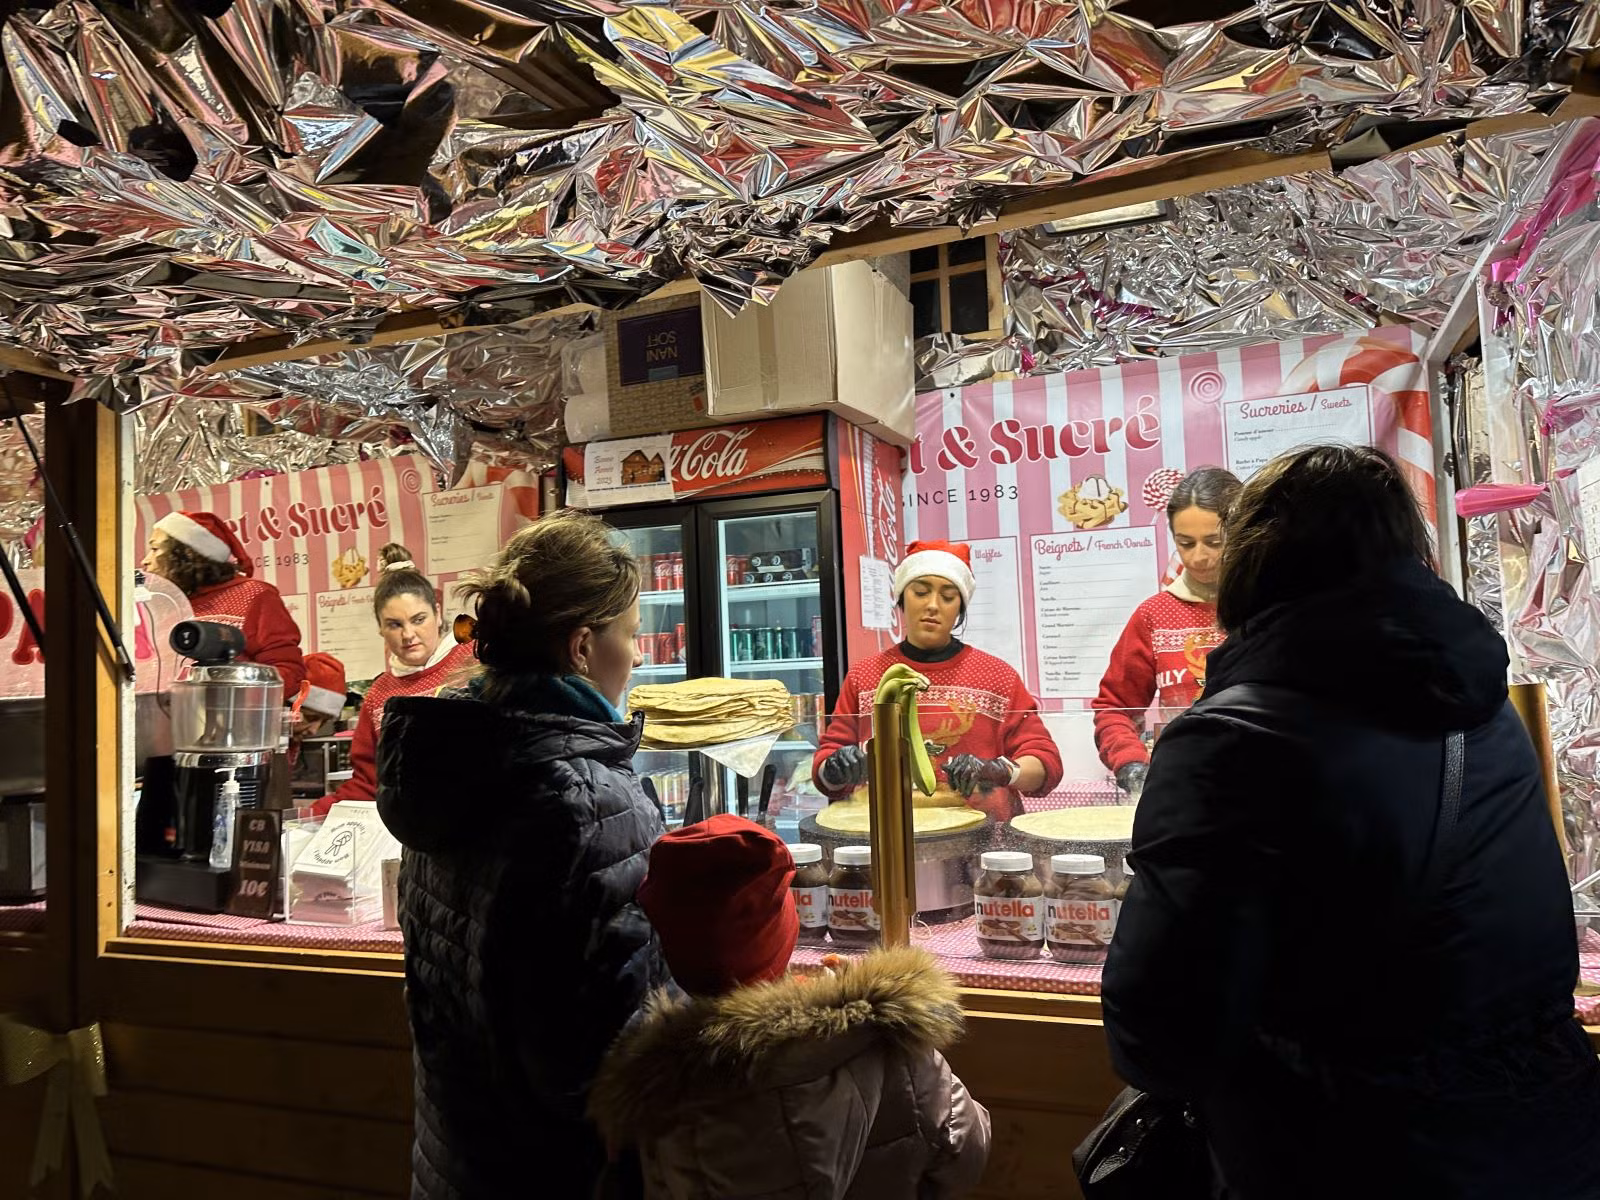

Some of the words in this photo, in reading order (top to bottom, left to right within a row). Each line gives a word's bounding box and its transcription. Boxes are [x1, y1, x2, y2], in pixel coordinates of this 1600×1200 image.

[1240, 400, 1307, 419] Sucreries
[1321, 397, 1352, 410] Sweets
[937, 426, 979, 473] &
[989, 395, 1161, 464] Sucré
[901, 488, 958, 507] INCE
[969, 484, 1019, 501] 1983
[257, 507, 282, 541] &
[288, 485, 387, 537] Sucré
[975, 549, 1003, 563] Waffles
[1035, 537, 1085, 561] Beignets
[1095, 540, 1124, 550] French
[1124, 537, 1153, 548] Donuts
[277, 553, 310, 567] 1983
[249, 819, 266, 832] CB
[243, 840, 270, 853] VISA
[238, 880, 269, 896] 10€
[976, 900, 1034, 918] nutella
[1048, 903, 1110, 921] nutella
